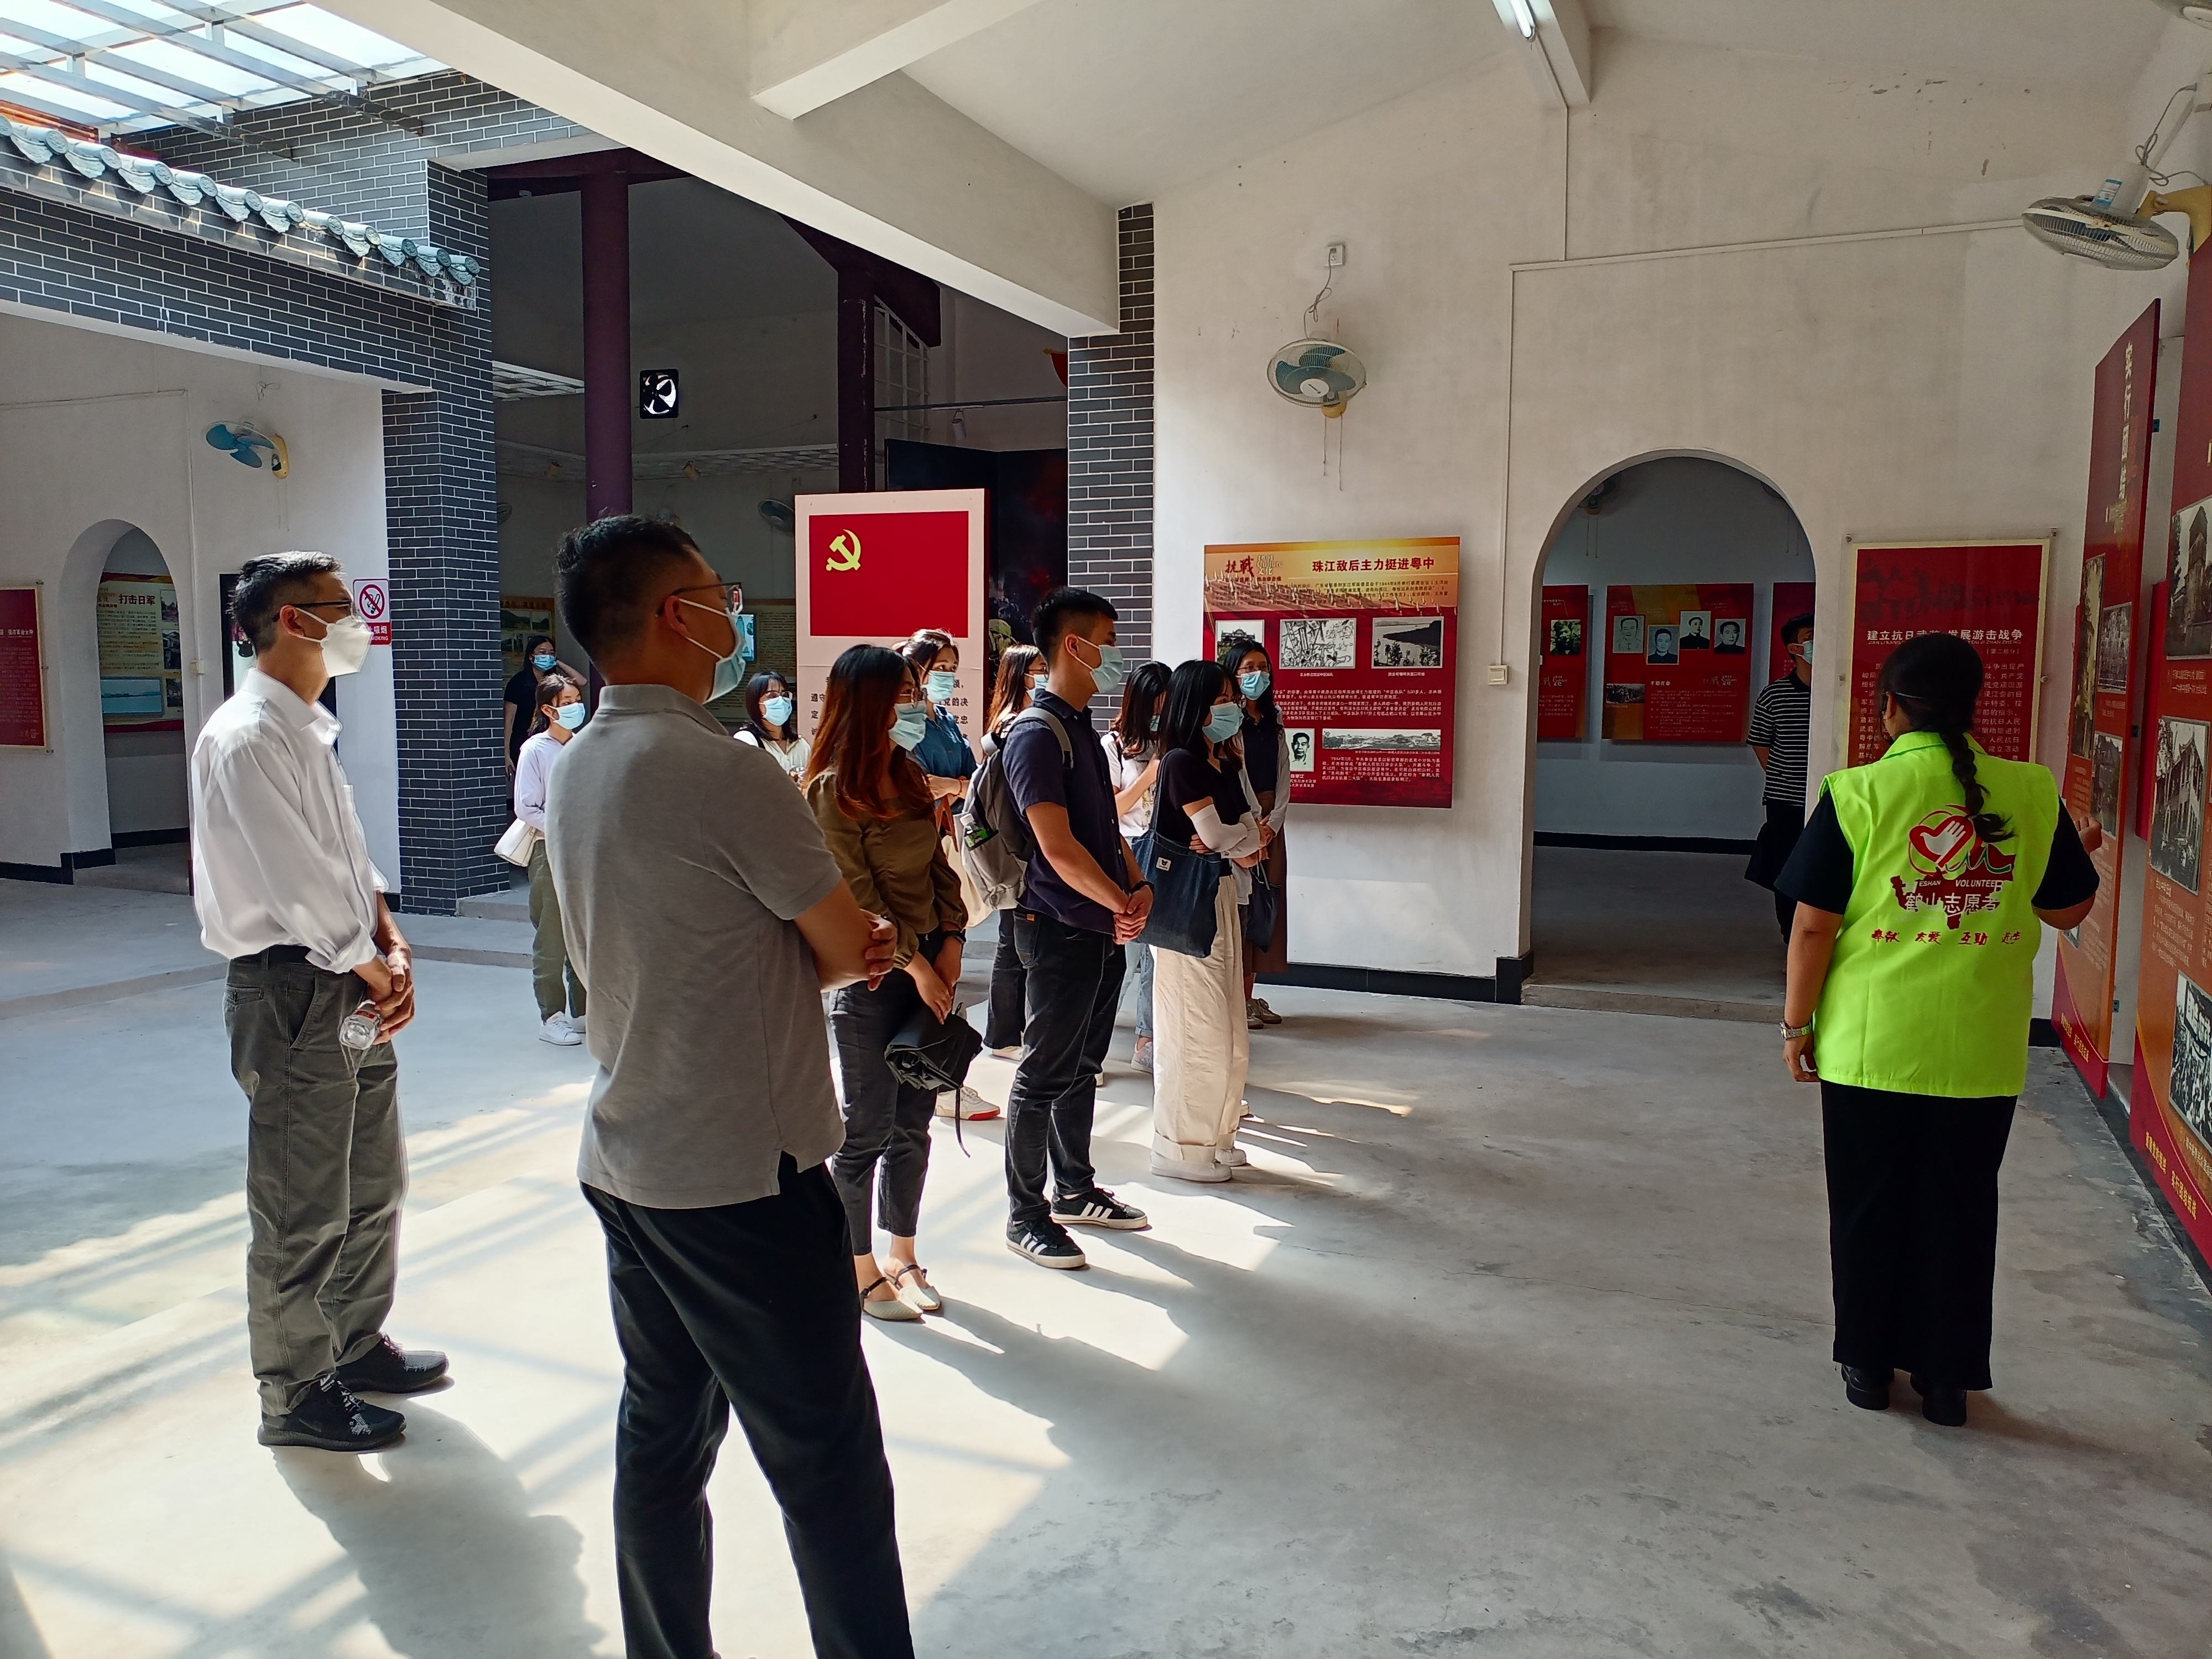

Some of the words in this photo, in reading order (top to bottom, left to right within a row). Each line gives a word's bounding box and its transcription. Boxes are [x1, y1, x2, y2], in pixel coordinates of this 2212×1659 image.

[1312, 556, 1434, 572] 珠江敌后主力挺进粤中
[119, 594, 155, 606] 打击日军
[368, 625, 387, 634] 止吸烟
[1867, 630, 1940, 640] 建立抗日武
[811, 711, 818, 719] 定
[1955, 879, 2004, 891] VOLUNTEER
[1905, 893, 2001, 915] 鹤山志愿者
[1914, 931, 1942, 945] 友爱
[1958, 932, 1988, 945] 互助
